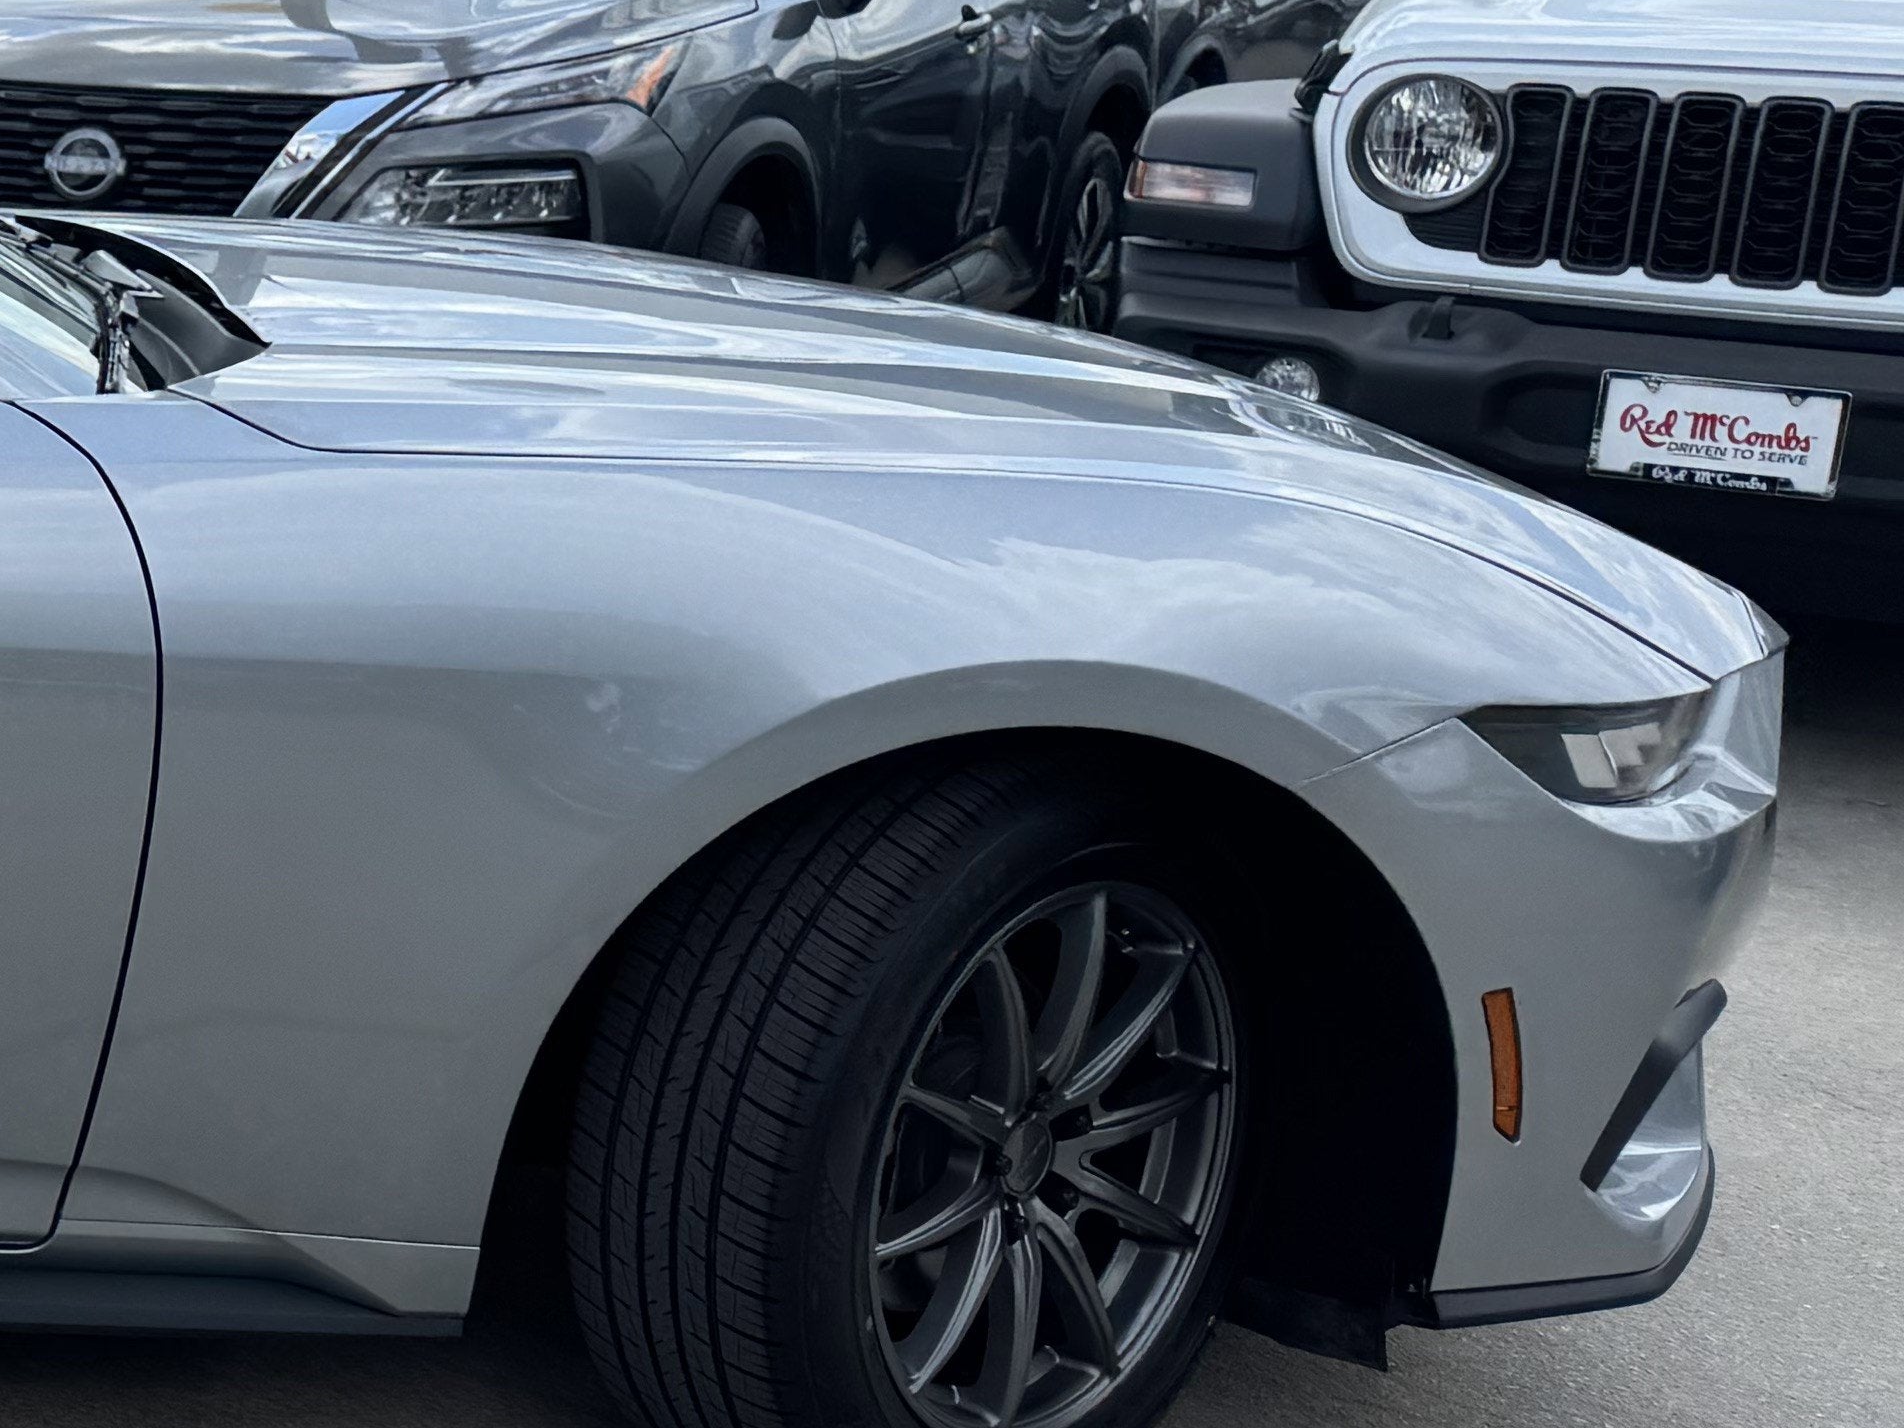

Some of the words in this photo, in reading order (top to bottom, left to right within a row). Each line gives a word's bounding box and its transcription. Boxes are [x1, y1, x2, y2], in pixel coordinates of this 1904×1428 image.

[1619, 403, 1678, 448] Red
[1683, 410, 1812, 454] McCombs
[1666, 440, 1728, 460] DRIVEN
[1732, 447, 1754, 460] TO
[1758, 450, 1808, 466] SERVE
